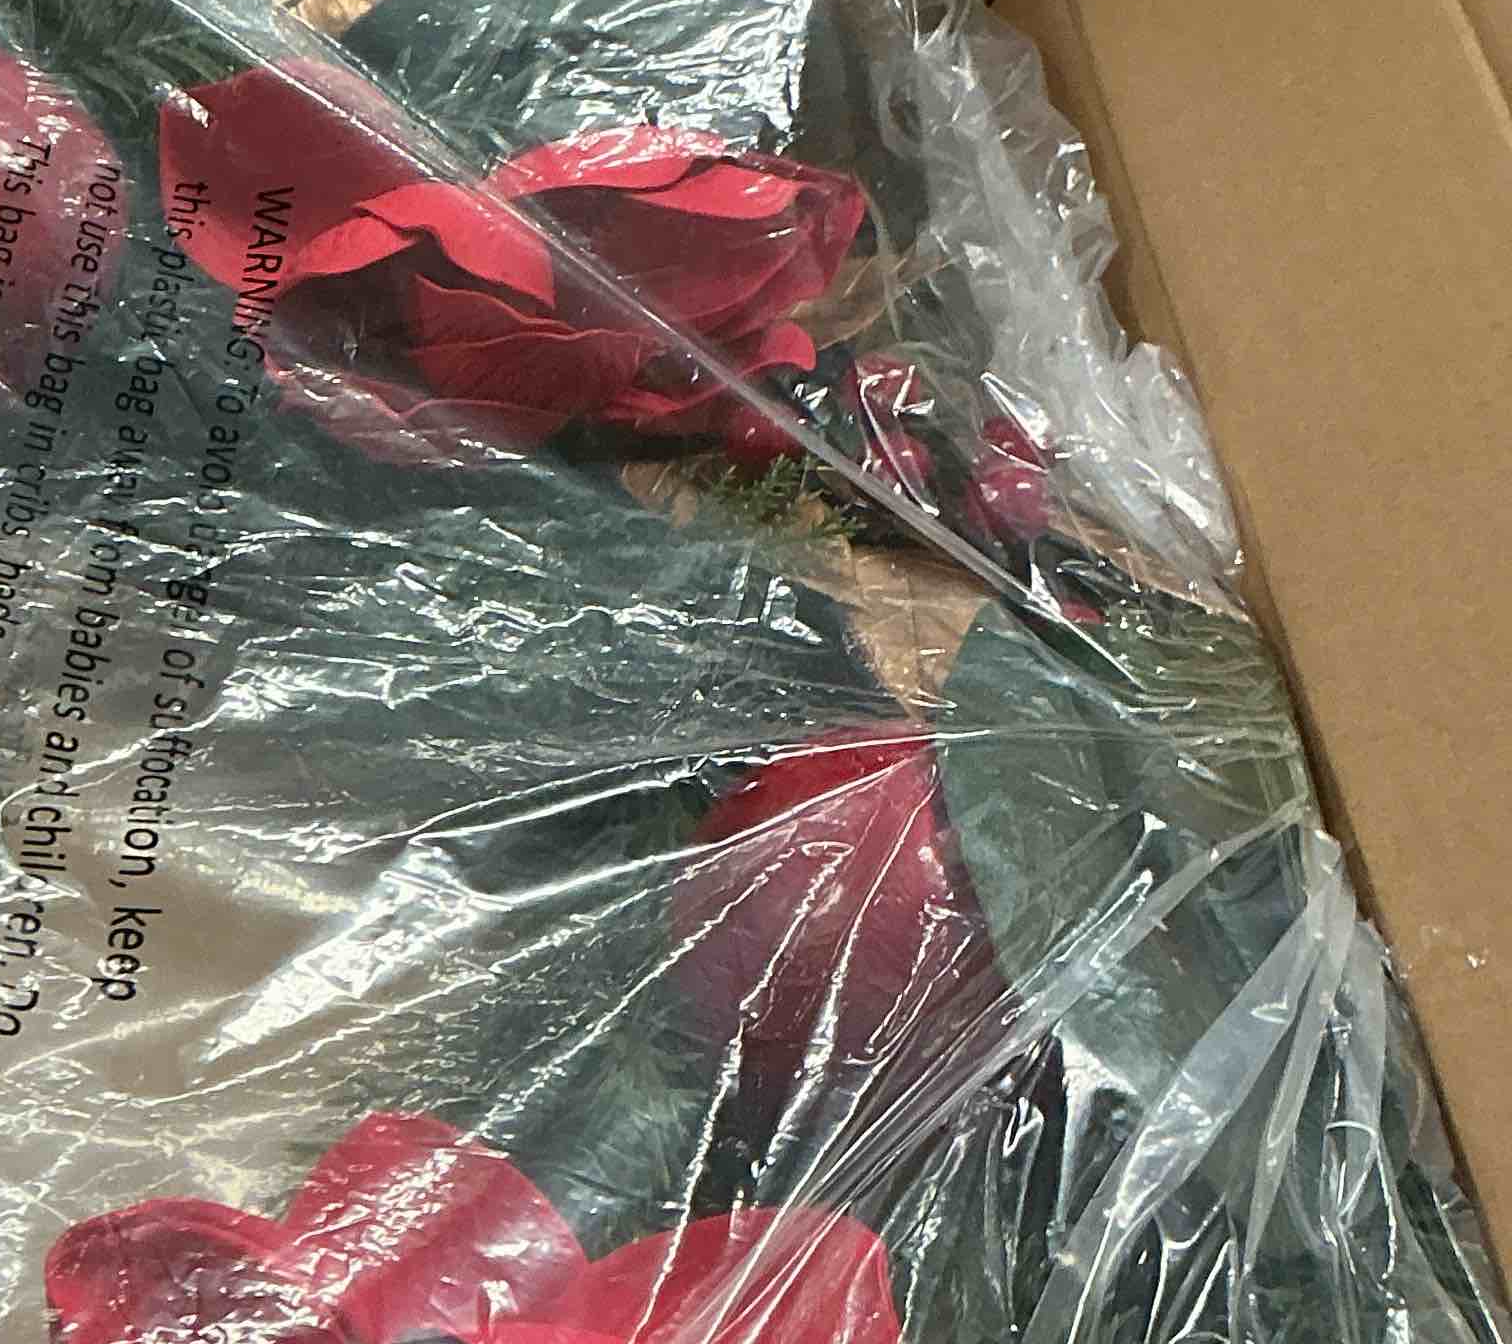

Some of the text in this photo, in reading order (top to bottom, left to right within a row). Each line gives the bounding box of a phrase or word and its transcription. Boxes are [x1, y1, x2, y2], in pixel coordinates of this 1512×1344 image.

[2, 138, 51, 195] This
[83, 163, 123, 217] not
[165, 181, 210, 241] this
[70, 220, 109, 273] use
[139, 247, 193, 343] plastic
[222, 186, 294, 371] WARNING:
[50, 283, 99, 344] this
[23, 353, 86, 416] bag
[114, 356, 174, 416] bag
[214, 385, 258, 413] To
[23, 421, 67, 454] in
[54, 606, 120, 722] babies
[160, 649, 204, 688] of
[32, 731, 79, 797] and
[107, 693, 194, 889] suffocation,
[89, 906, 161, 1001] keep
